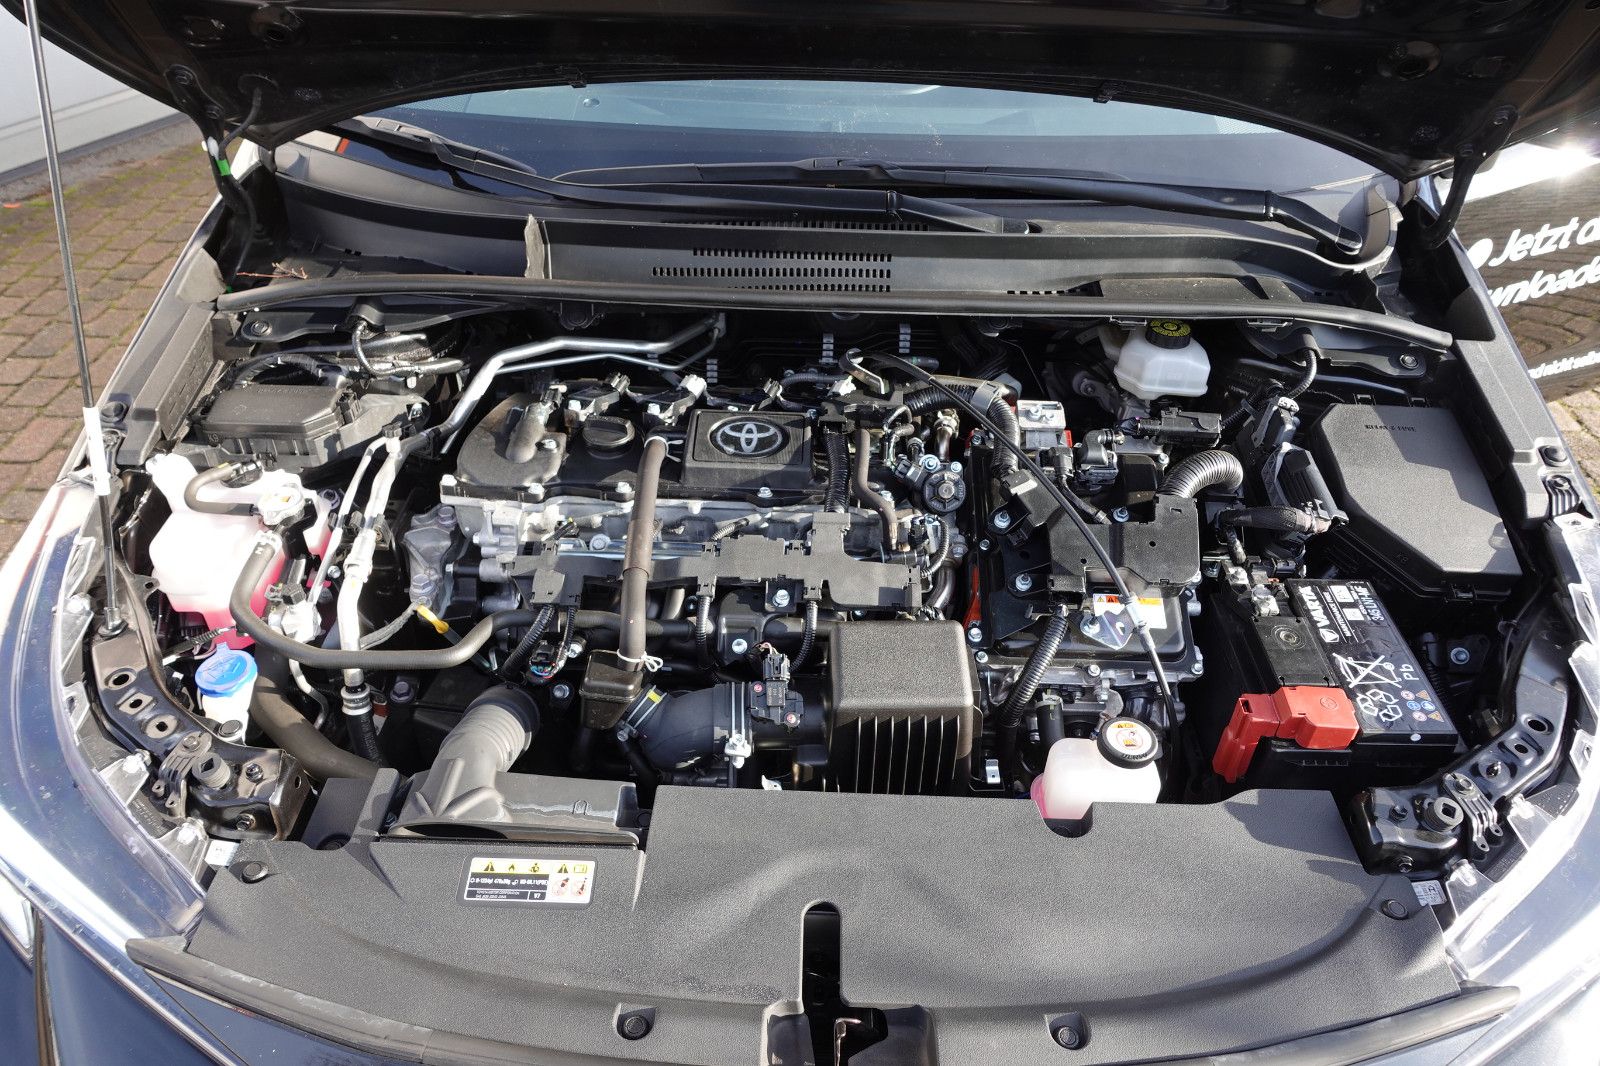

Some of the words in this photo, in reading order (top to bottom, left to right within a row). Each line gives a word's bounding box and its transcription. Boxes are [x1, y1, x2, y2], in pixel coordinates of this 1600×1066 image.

[1488, 216, 1580, 267] Jetzt
[1298, 585, 1331, 628] VARTA
[1399, 663, 1420, 681] Pb
